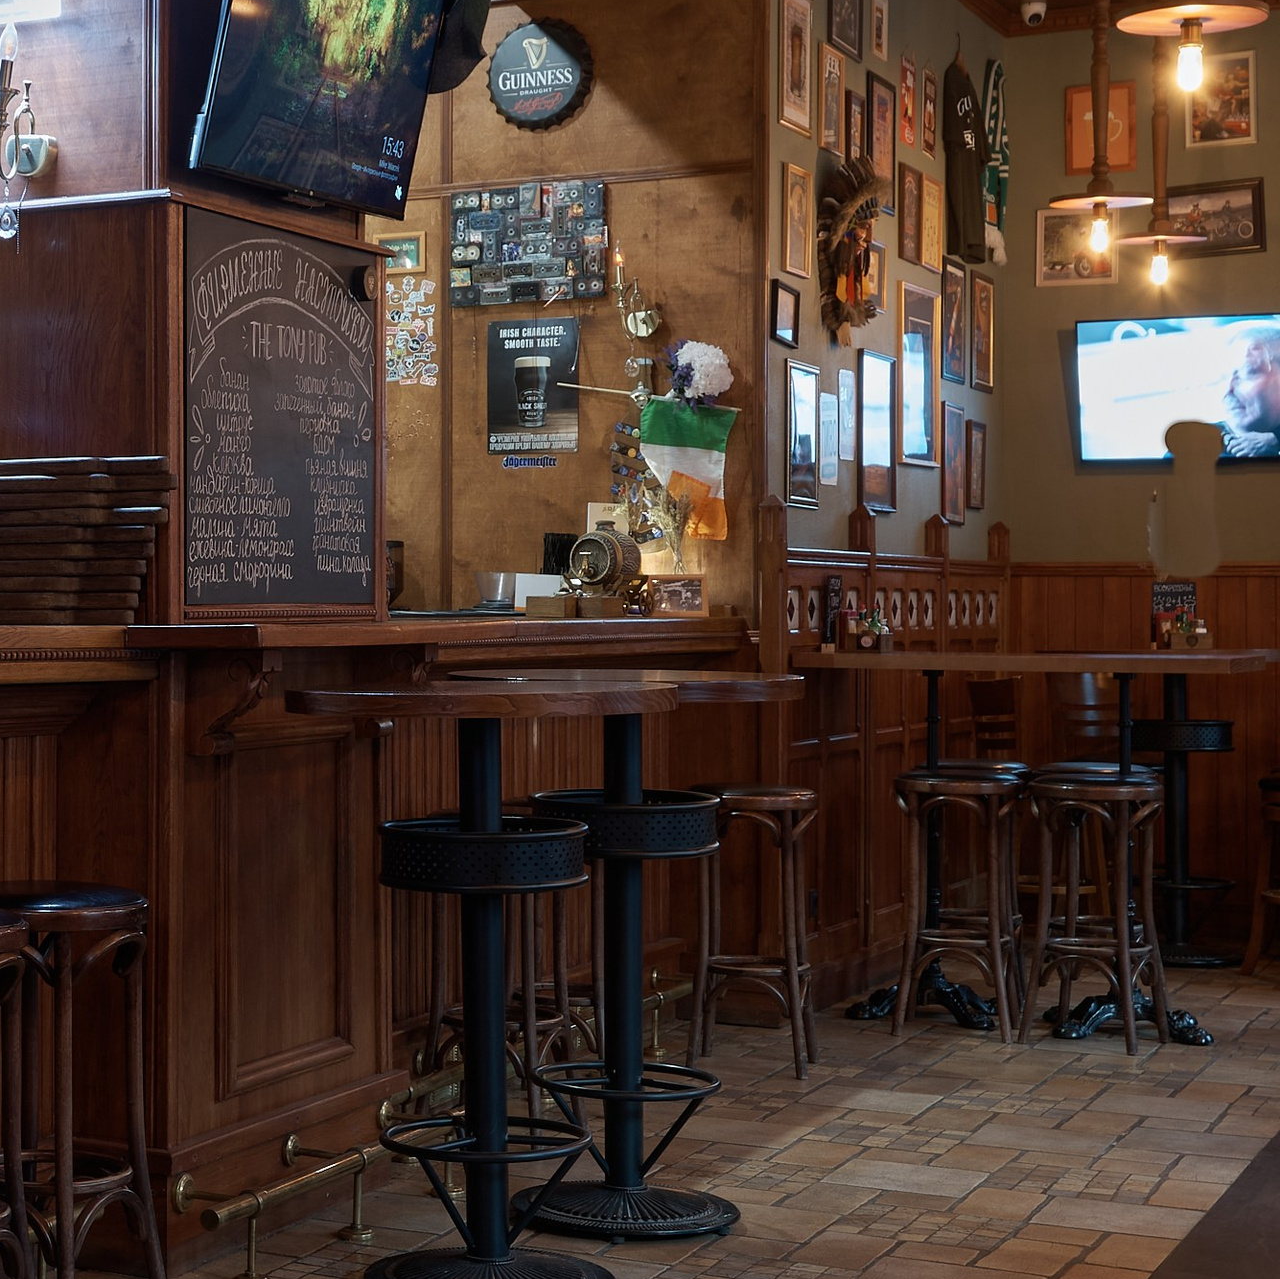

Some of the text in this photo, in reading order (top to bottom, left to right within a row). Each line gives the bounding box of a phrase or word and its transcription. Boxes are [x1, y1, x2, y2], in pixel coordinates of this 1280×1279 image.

[498, 67, 573, 91] GUINNESS
[519, 87, 553, 97] DRAUGHT
[382, 135, 405, 159] 15:43
[250, 321, 328, 366] THE TONY PUB
[499, 328, 521, 339] IRISH
[504, 338, 535, 350] SMOOTH
[219, 356, 250, 392] банан
[200, 374, 253, 414] облепиха
[217, 432, 252, 453] манго
[212, 452, 255, 475] клюква
[187, 560, 294, 599] черная смородина
